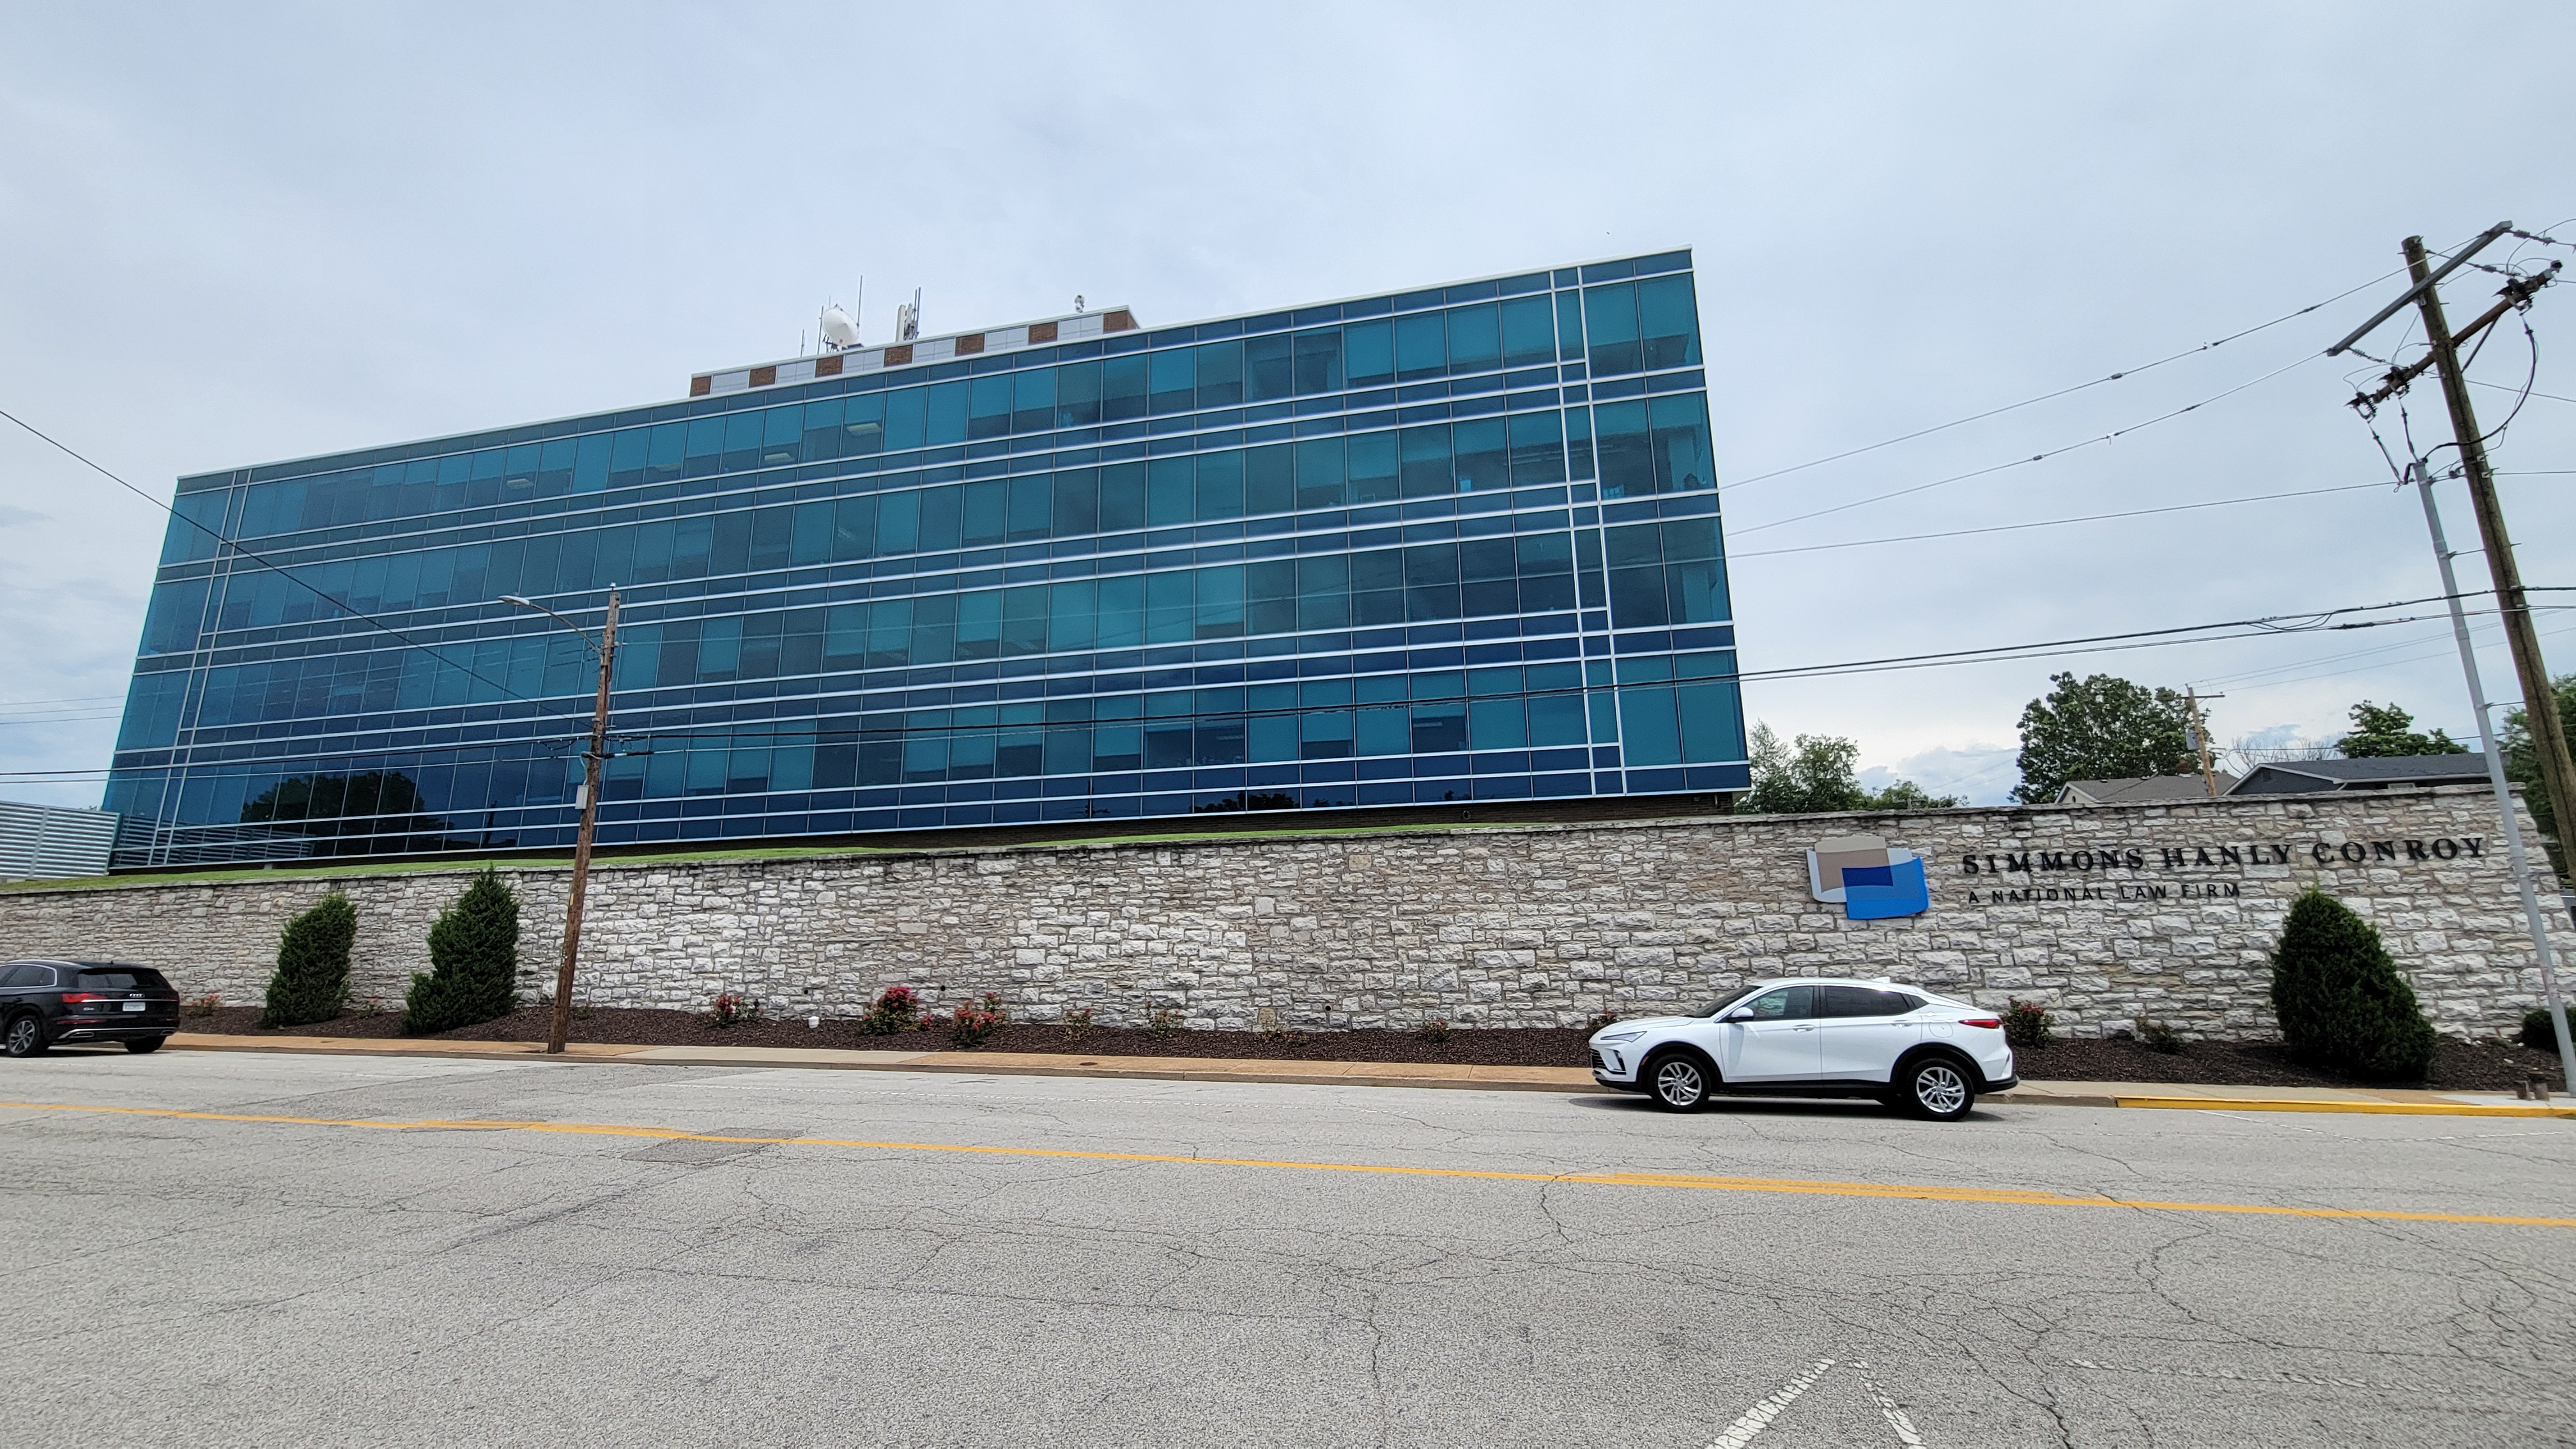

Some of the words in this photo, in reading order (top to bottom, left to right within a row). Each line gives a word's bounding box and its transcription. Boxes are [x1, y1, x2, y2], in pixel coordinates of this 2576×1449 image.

[1962, 848, 2144, 874] SIMMONS
[2160, 844, 2292, 867] HANLY
[2312, 837, 2484, 863] CONROY
[1968, 891, 1980, 904] A
[1991, 887, 2108, 903] NATIONAL
[2119, 885, 2166, 900] LAW
[2181, 883, 2240, 898] FIRM
